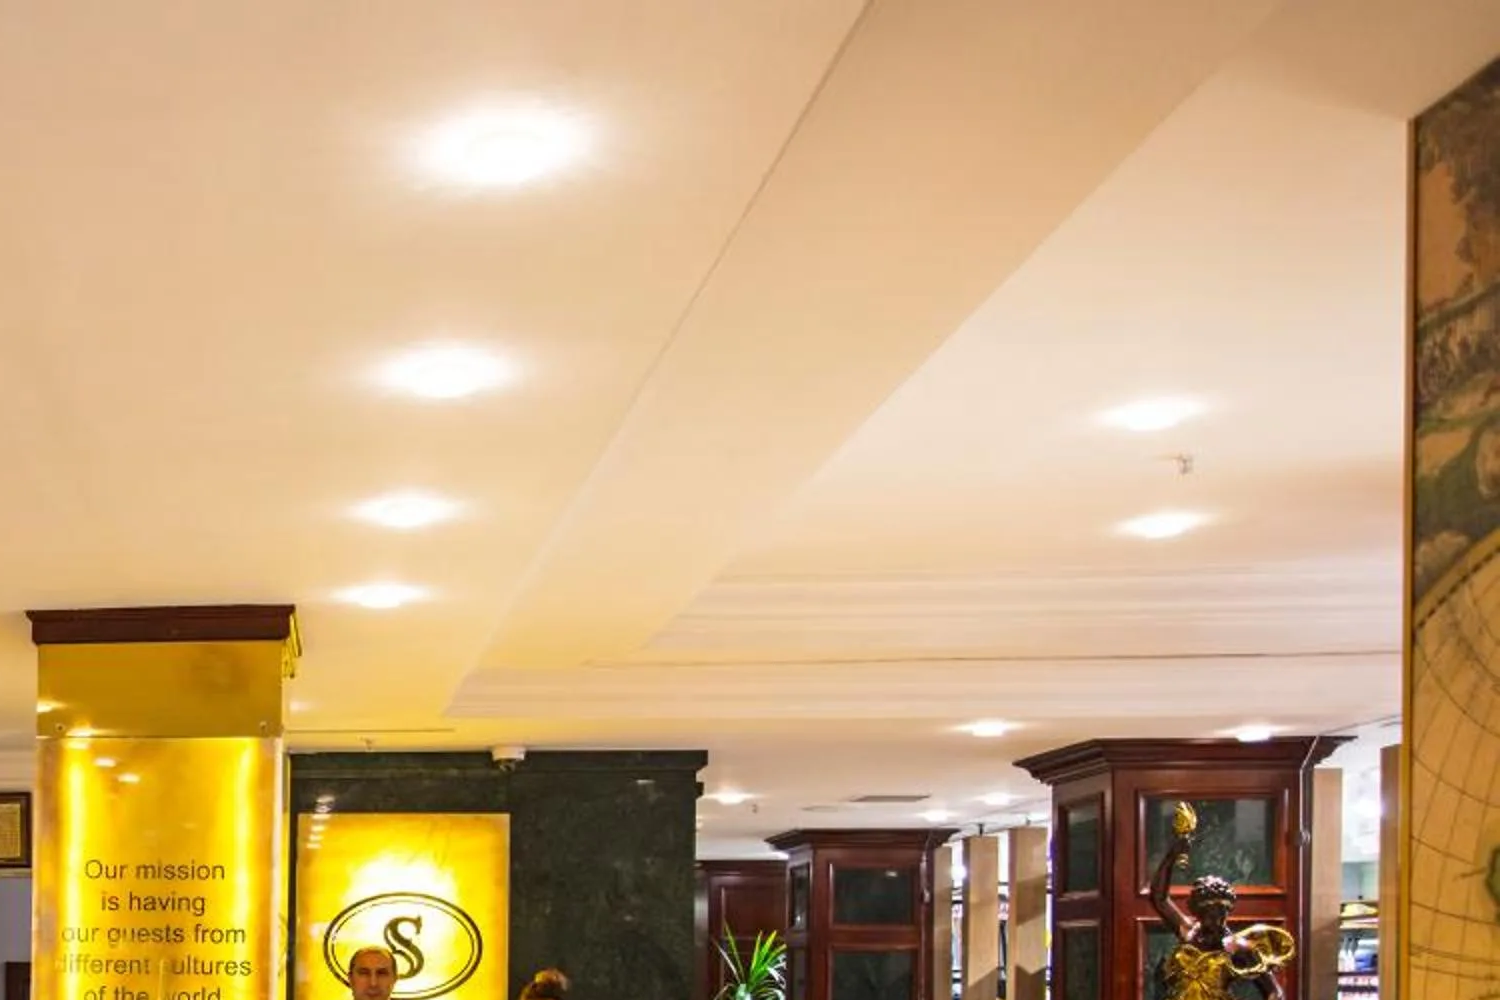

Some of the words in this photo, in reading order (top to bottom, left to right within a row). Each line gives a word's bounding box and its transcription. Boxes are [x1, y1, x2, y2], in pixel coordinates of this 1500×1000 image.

[84, 859, 128, 880] Our
[136, 859, 226, 880] mission
[100, 892, 120, 911] is
[129, 891, 206, 917] having
[61, 926, 99, 943] our
[107, 924, 185, 949] guests
[193, 923, 247, 944] from
[164, 954, 252, 977] ultures
